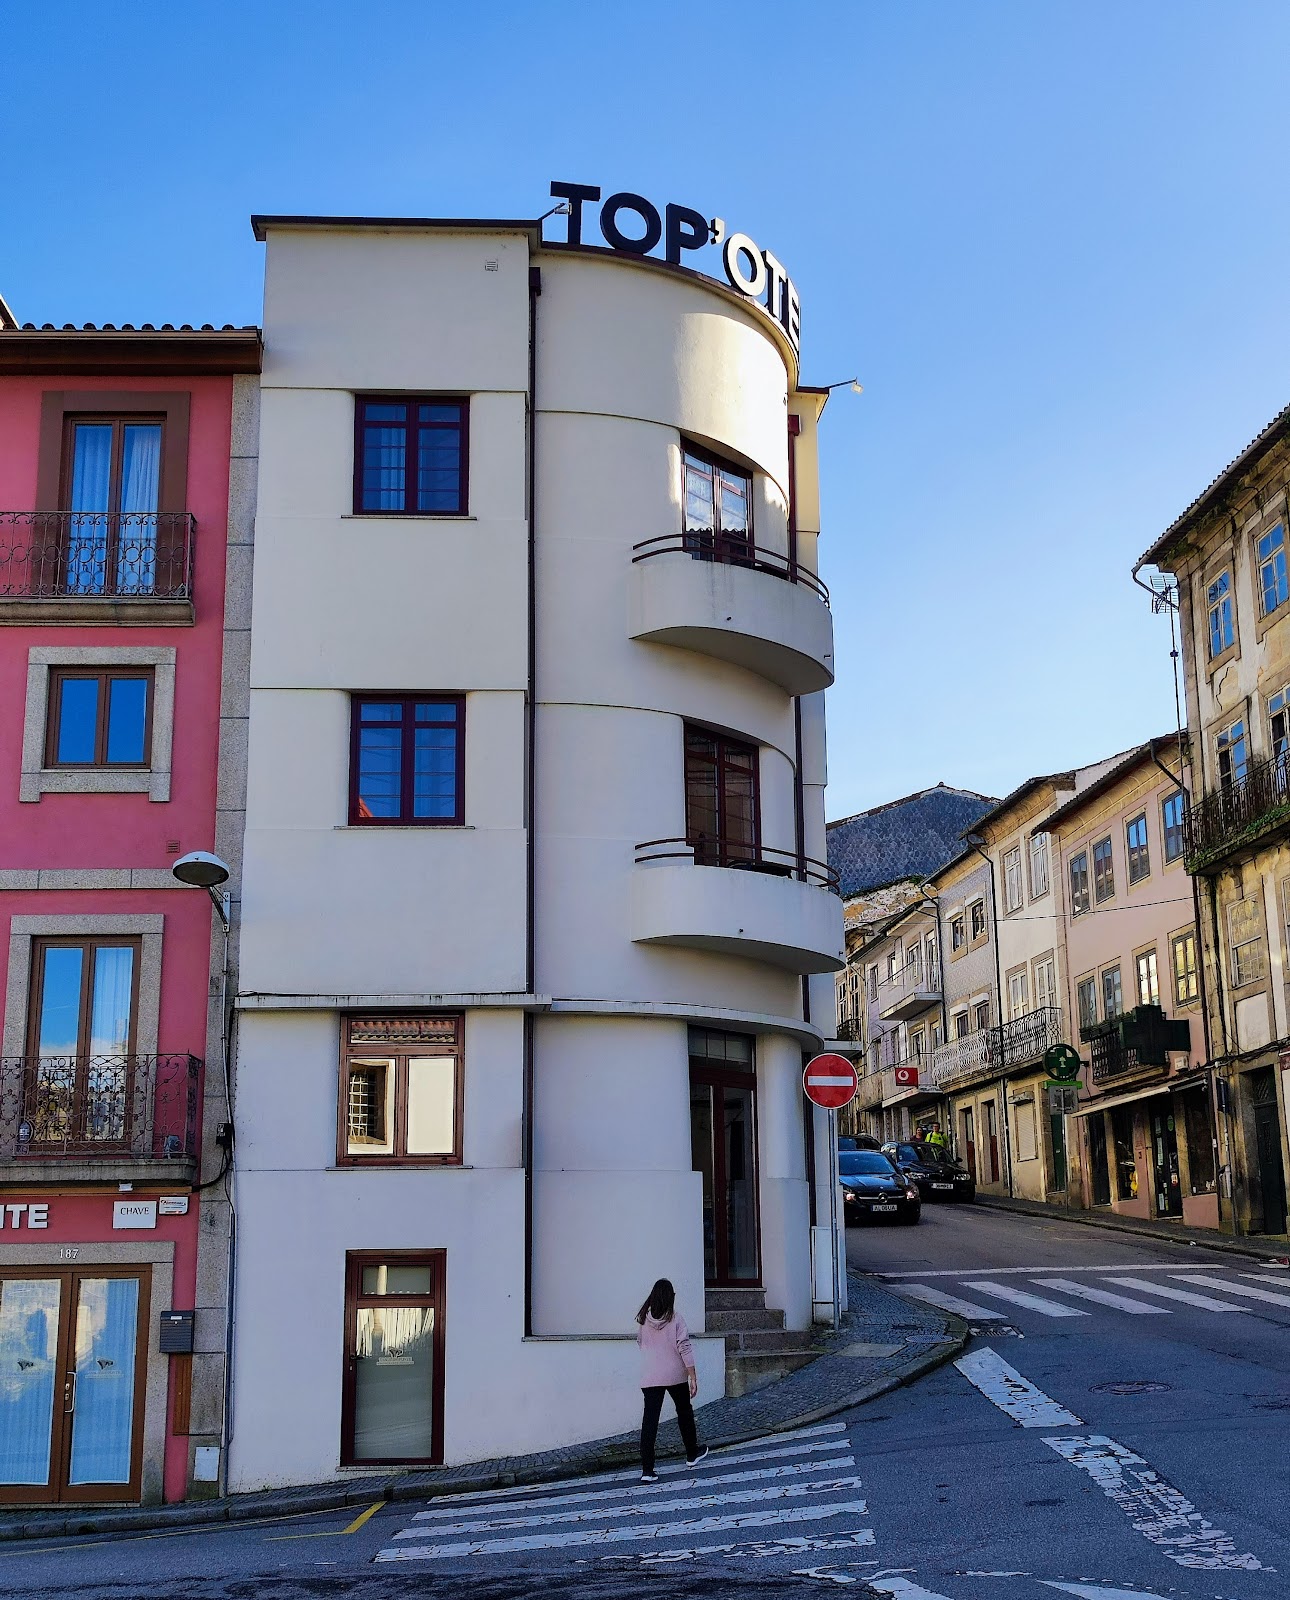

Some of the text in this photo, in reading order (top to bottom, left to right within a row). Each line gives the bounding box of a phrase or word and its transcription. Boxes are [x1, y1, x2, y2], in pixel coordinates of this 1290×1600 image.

[0, 1203, 49, 1229] TE
[120, 1207, 150, 1216] CHAVE
[60, 1248, 79, 1259] 187
